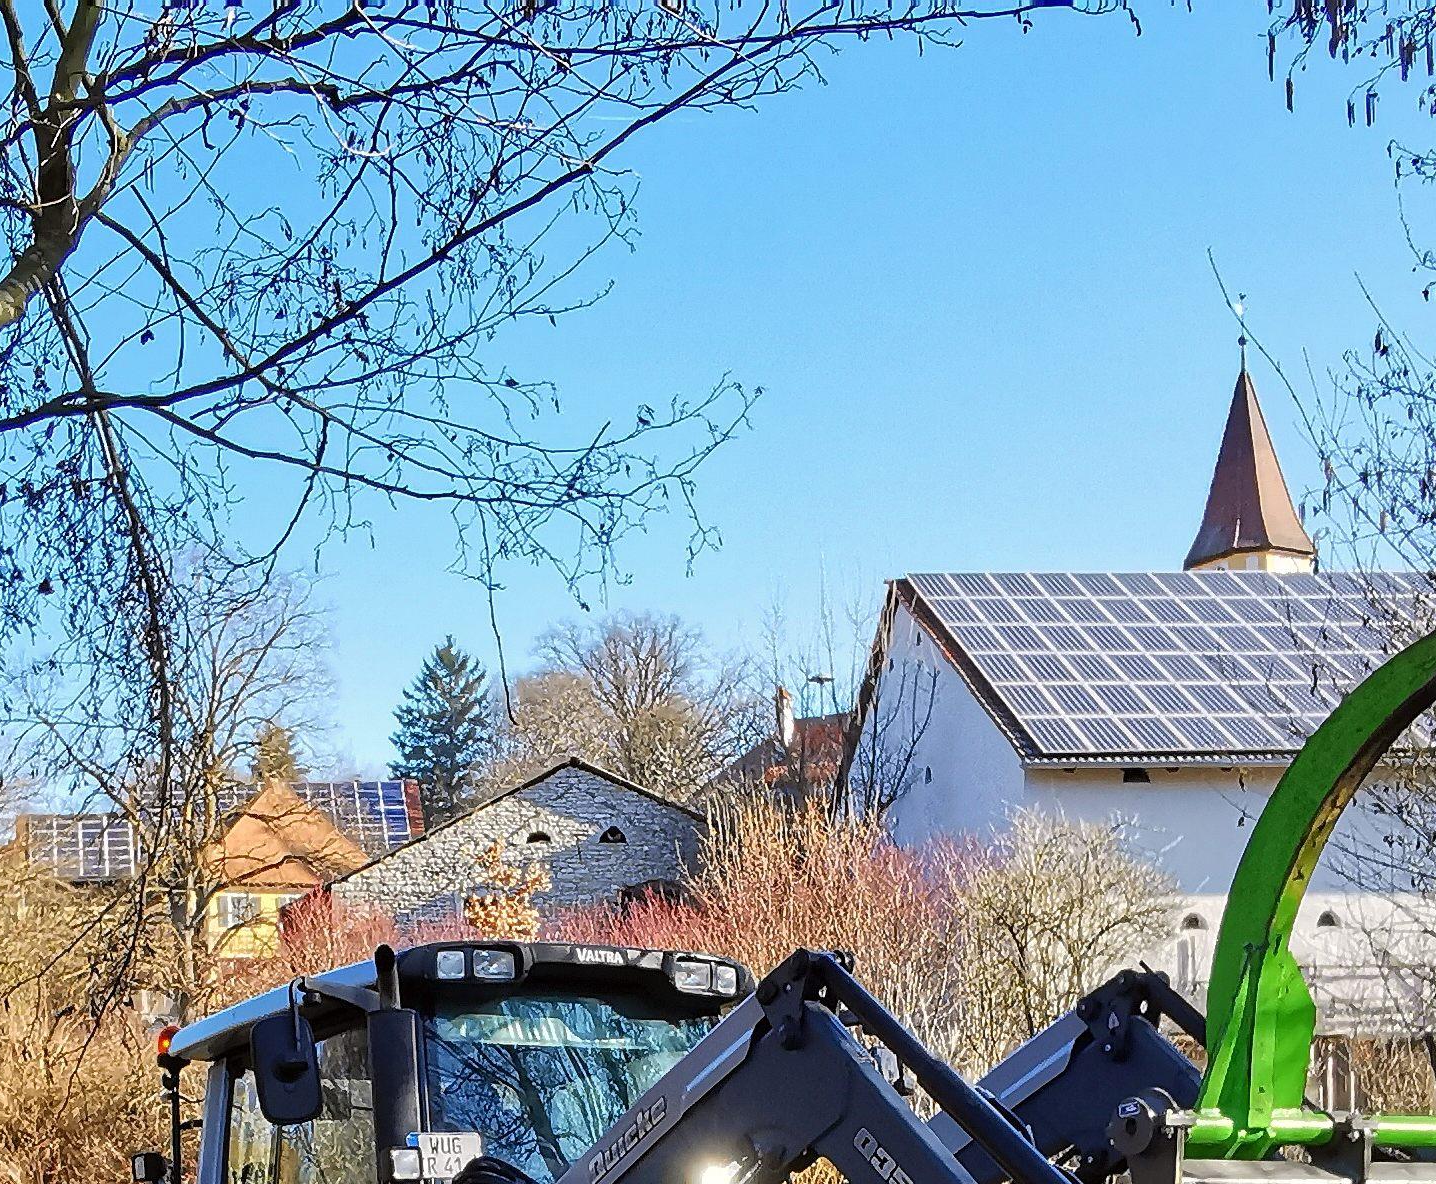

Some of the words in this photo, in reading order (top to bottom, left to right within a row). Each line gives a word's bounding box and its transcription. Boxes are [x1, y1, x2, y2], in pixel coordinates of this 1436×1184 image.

[576, 947, 624, 964] VALTRA
[429, 1136, 462, 1154] WUG
[427, 1156, 438, 1175] R
